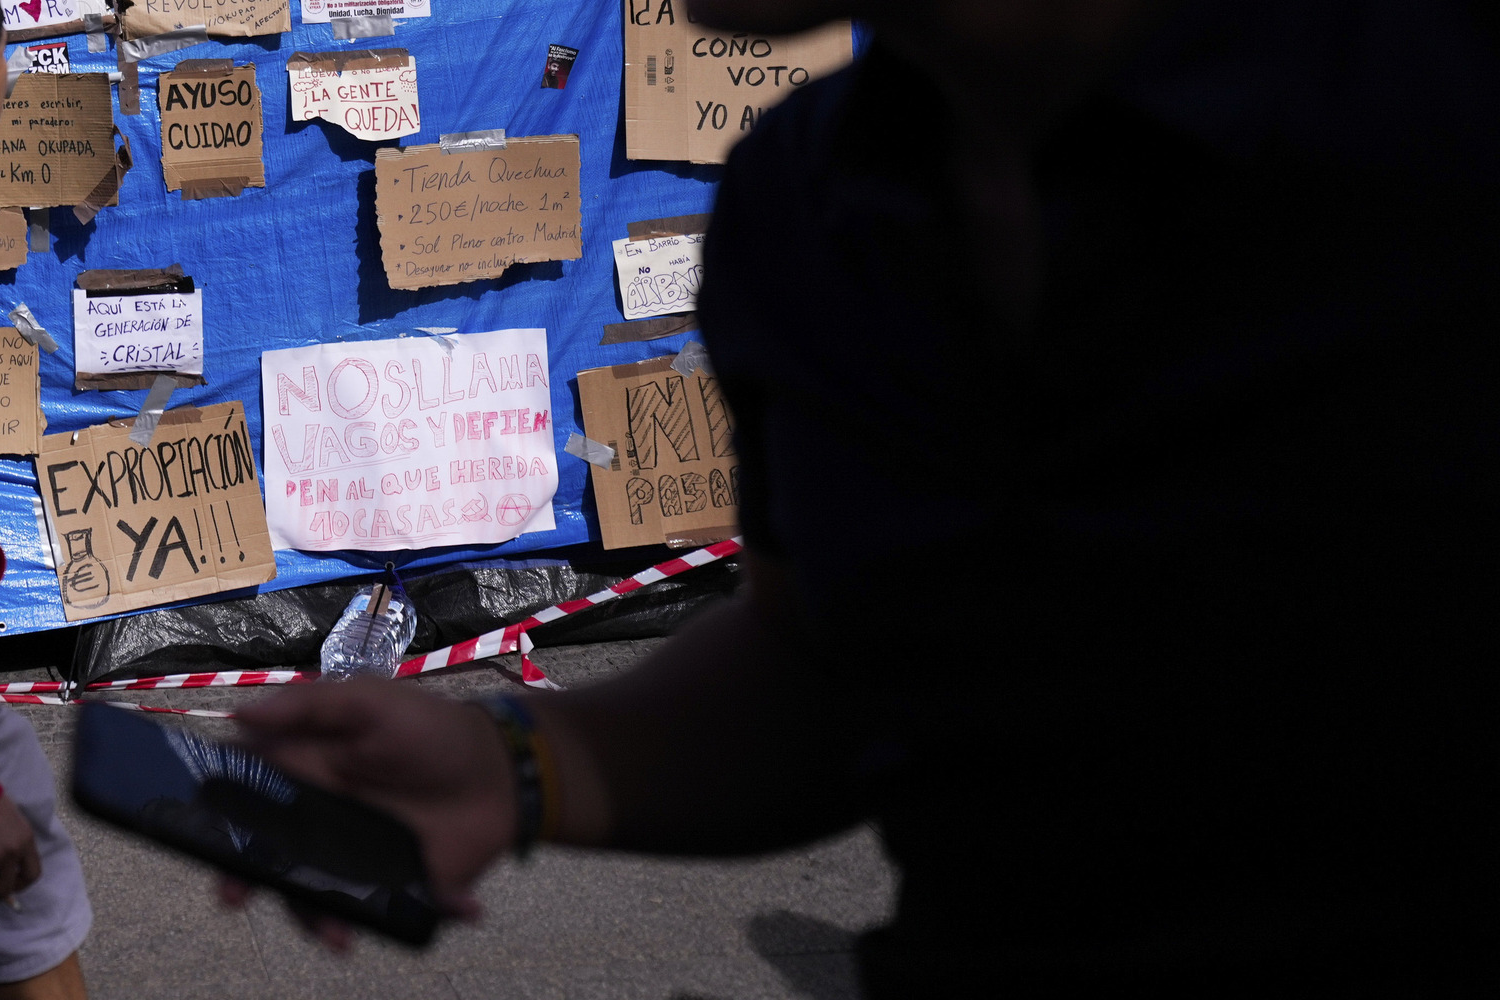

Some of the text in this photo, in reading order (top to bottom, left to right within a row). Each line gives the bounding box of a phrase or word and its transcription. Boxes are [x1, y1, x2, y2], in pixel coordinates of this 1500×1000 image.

[692, 33, 773, 58] COÑO
[337, 80, 396, 100] GENTE
[726, 66, 810, 87] VOTO
[345, 103, 421, 132] QUEDA!
[695, 100, 728, 131] YO
[402, 157, 568, 193] Tienda Quechua
[412, 235, 442, 256] Sol
[450, 232, 486, 251] Pleno
[533, 222, 577, 242] Madrid
[458, 262, 474, 272] no
[86, 298, 187, 316] AQUÍ ESTÁ LA
[174, 314, 192, 330] DE
[272, 417, 420, 474] VAGOS
[426, 411, 447, 449] Y
[47, 408, 254, 518] EXPROPIACIÓN
[346, 476, 374, 500] AL
[380, 466, 441, 496] QUE
[449, 455, 549, 486] HEREDA
